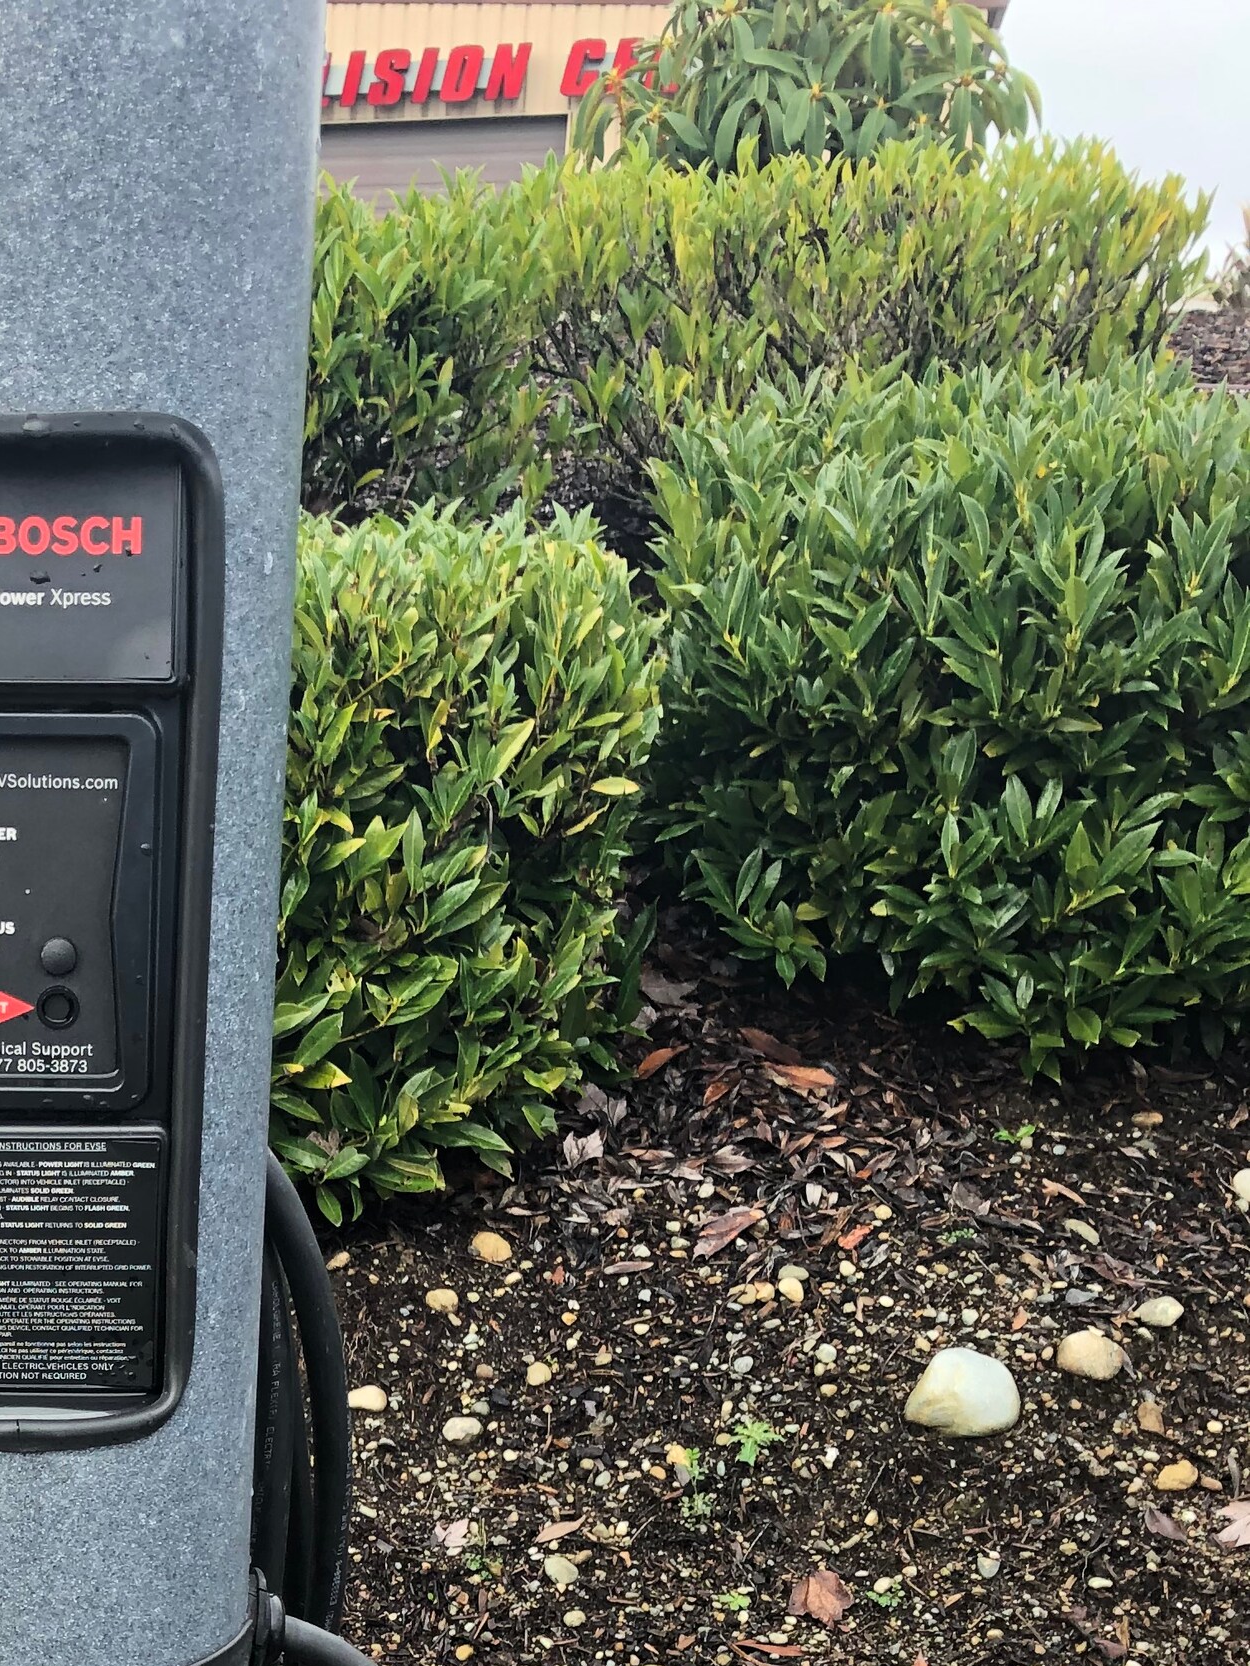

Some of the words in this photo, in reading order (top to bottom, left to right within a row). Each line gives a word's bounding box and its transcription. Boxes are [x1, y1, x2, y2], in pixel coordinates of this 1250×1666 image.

[50, 588, 112, 609] Xpress
[32, 1041, 93, 1058] Support
[17, 1059, 88, 1073] 805-3873
[64, 1142, 82, 1150] FOR
[84, 1142, 107, 1150] EVSE
[2, 1362, 45, 1371] ELECTRIC
[46, 1362, 88, 1371] VEHICLES
[91, 1362, 114, 1372] ONLY
[21, 1371, 38, 1380] NOT
[42, 1371, 87, 1380] REQUIRED
